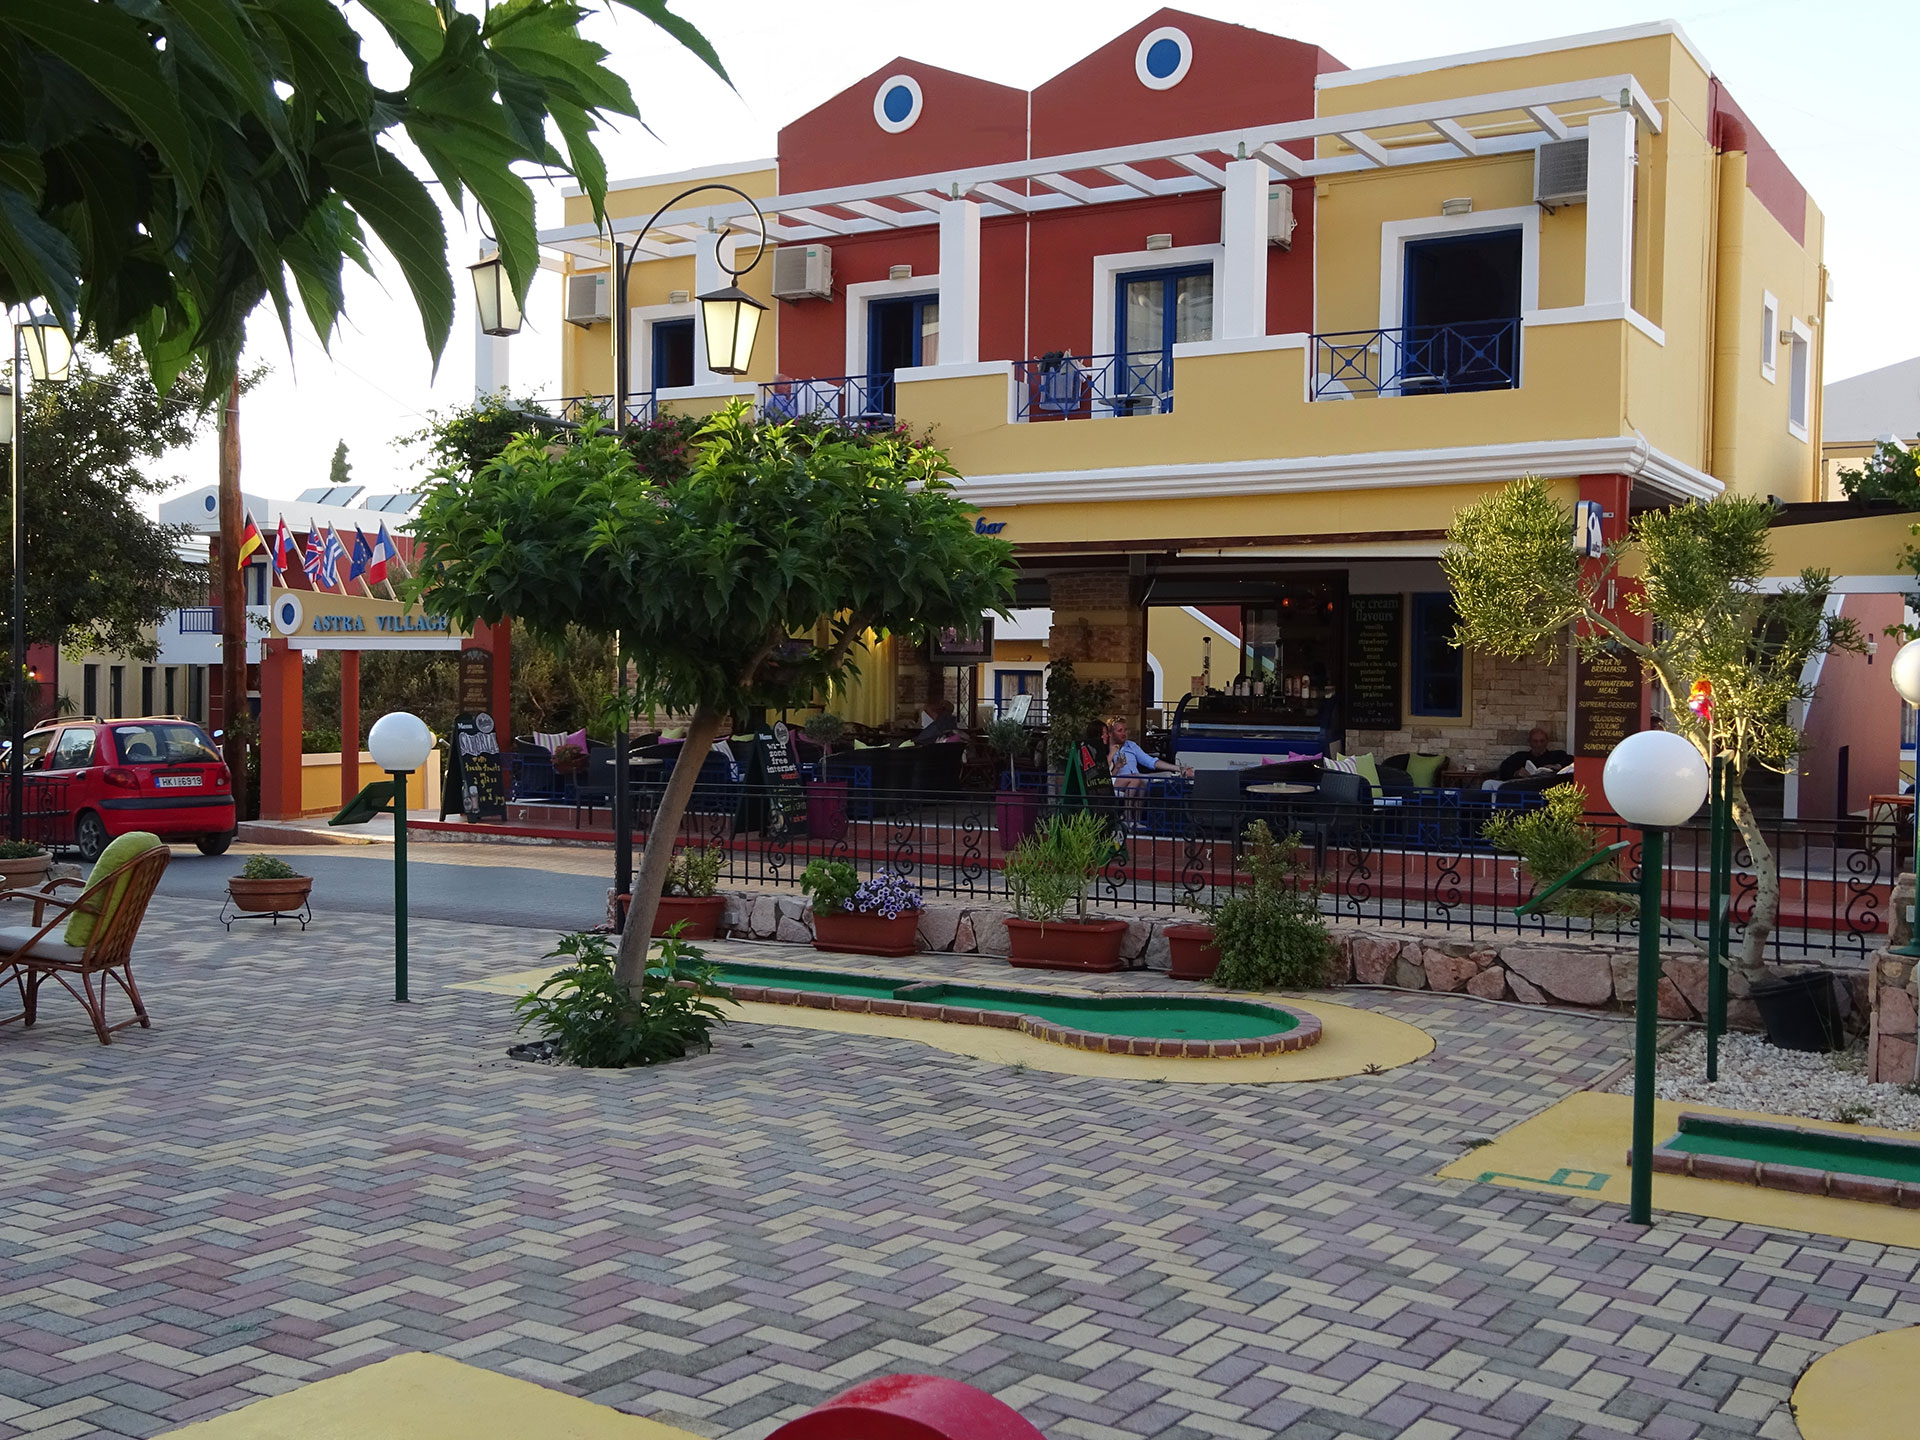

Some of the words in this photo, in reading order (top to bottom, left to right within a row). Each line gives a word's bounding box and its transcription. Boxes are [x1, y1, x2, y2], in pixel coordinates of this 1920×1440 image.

[975, 516, 1007, 535] bar
[1351, 599, 1366, 609] ice
[1368, 598, 1398, 609] cream
[1355, 608, 1394, 622] flavours
[312, 615, 365, 632] ASTRA
[376, 615, 448, 632] VILLAGE
[1596, 658, 1613, 666] OVER
[1590, 665, 1628, 673] BREAKFASTS
[1584, 679, 1635, 688] MOUTHWATERING
[1598, 687, 1619, 695] MEALS
[1579, 700, 1606, 709] SUPREME
[1607, 701, 1638, 709] DESSERTS
[1588, 715, 1627, 723] DELICIOUSLY
[1594, 722, 1620, 730] COOLING
[1589, 729, 1600, 737] ICE
[1600, 729, 1625, 738] CREAMS
[1583, 743, 1607, 751] SUNDAY
[769, 750, 787, 758] zone
[771, 757, 789, 765] free
[766, 763, 797, 774] internet
[181, 776, 202, 786] 6919
